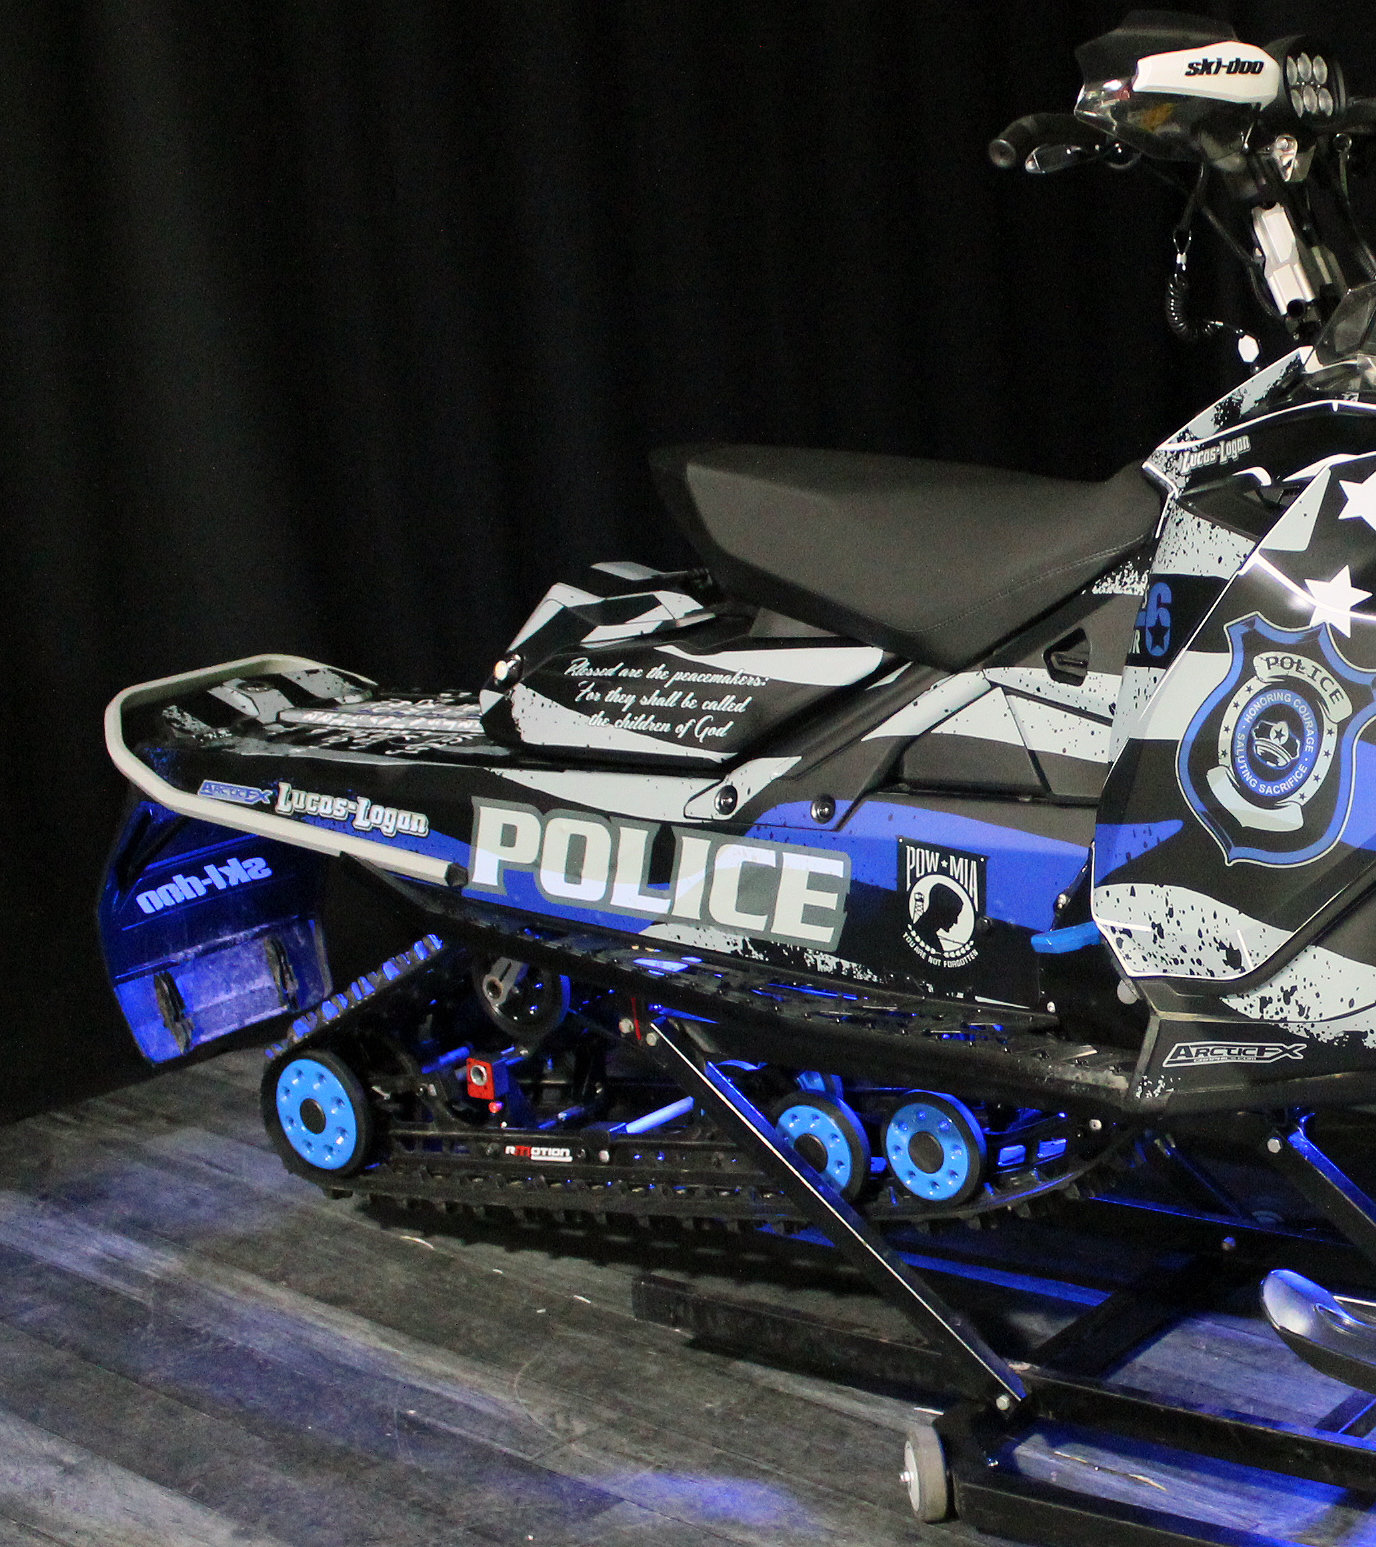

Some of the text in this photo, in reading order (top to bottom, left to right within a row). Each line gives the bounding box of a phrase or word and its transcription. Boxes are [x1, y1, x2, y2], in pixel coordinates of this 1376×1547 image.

[1185, 56, 1264, 76] ski-doo
[1180, 435, 1251, 476] Lucas-Logan
[564, 658, 769, 688] Blessed are the peacemakers:
[1265, 655, 1344, 705] POLICE
[575, 681, 752, 713] For they shall be called
[588, 710, 734, 743] the children of God
[1244, 692, 1315, 753] HONORING COURAGE
[1236, 733, 1308, 795] SALUTING SACRIFICE
[275, 781, 430, 838] Lucas-Logan
[470, 803, 847, 945] POLICE
[906, 845, 979, 912] POW MIA
[902, 931, 979, 968] YOU ARE NOT FORGOTTEN
